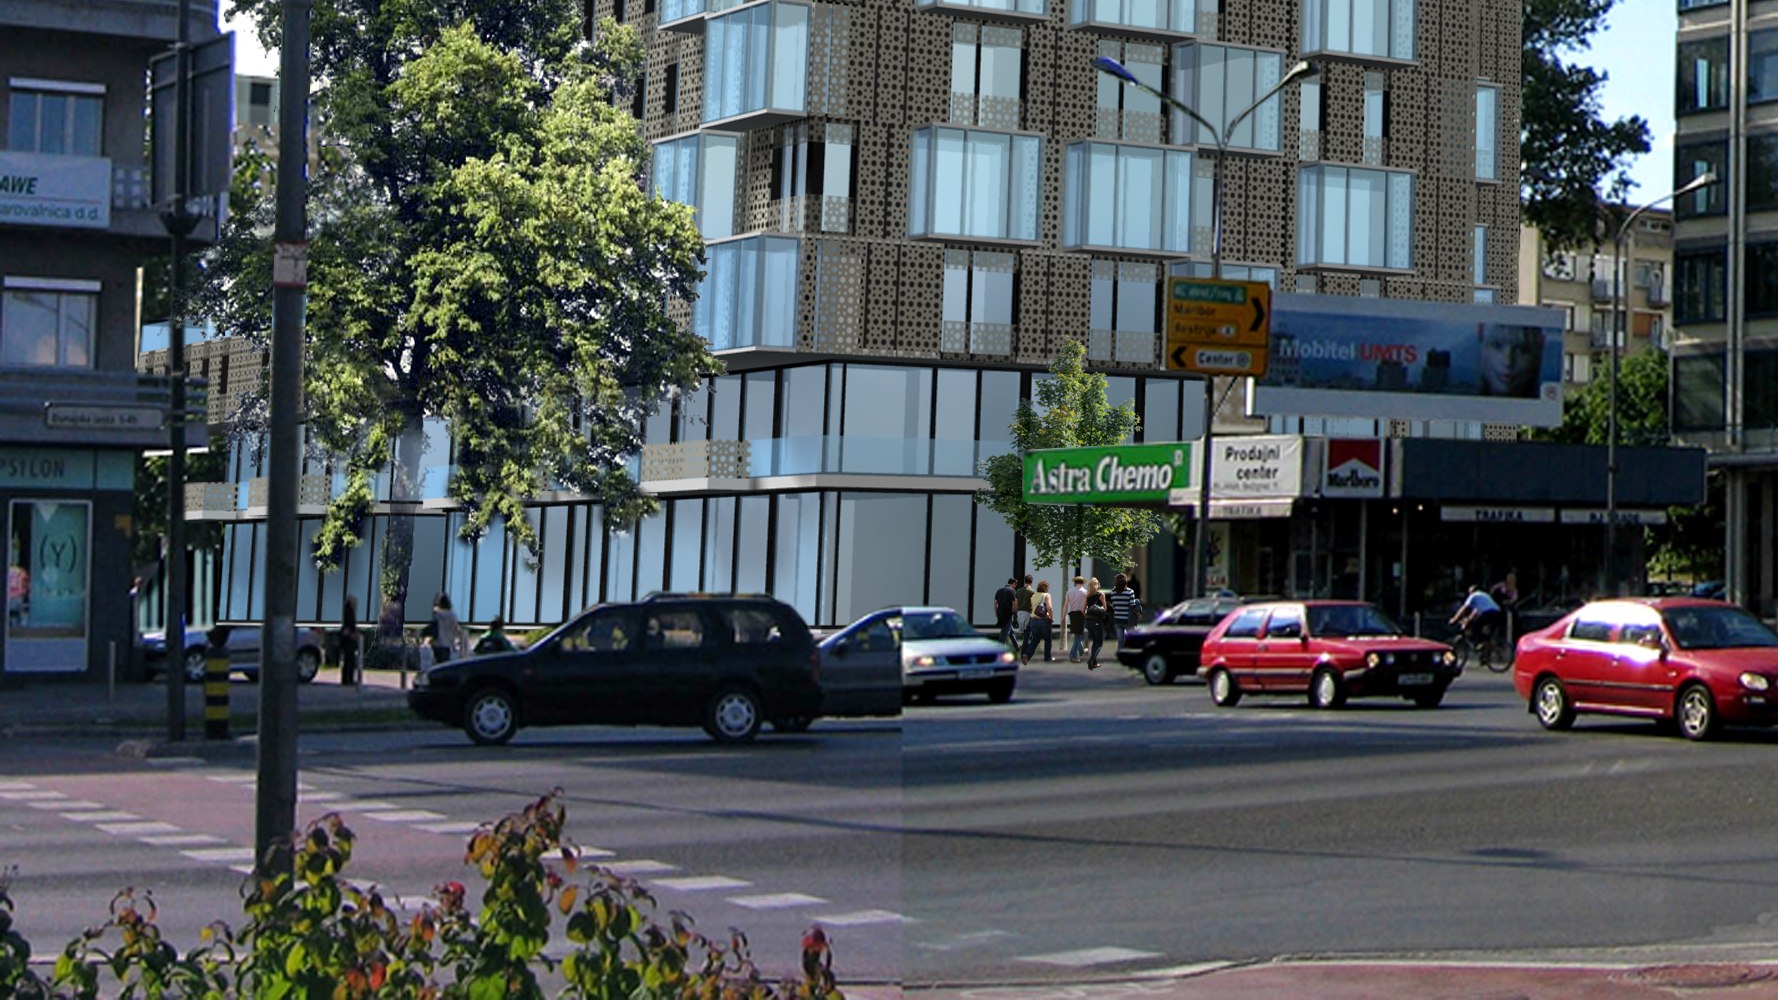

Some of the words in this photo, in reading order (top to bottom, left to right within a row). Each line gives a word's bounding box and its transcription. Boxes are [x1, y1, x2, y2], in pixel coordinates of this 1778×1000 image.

[1279, 339, 1356, 360] Mobitel
[1359, 343, 1418, 363] UMTS
[1225, 443, 1281, 463] Prodajni
[1028, 458, 1091, 495] Astra
[1095, 455, 1173, 492] Chemo
[1236, 465, 1279, 481] center
[1327, 468, 1380, 489] Marlboro
